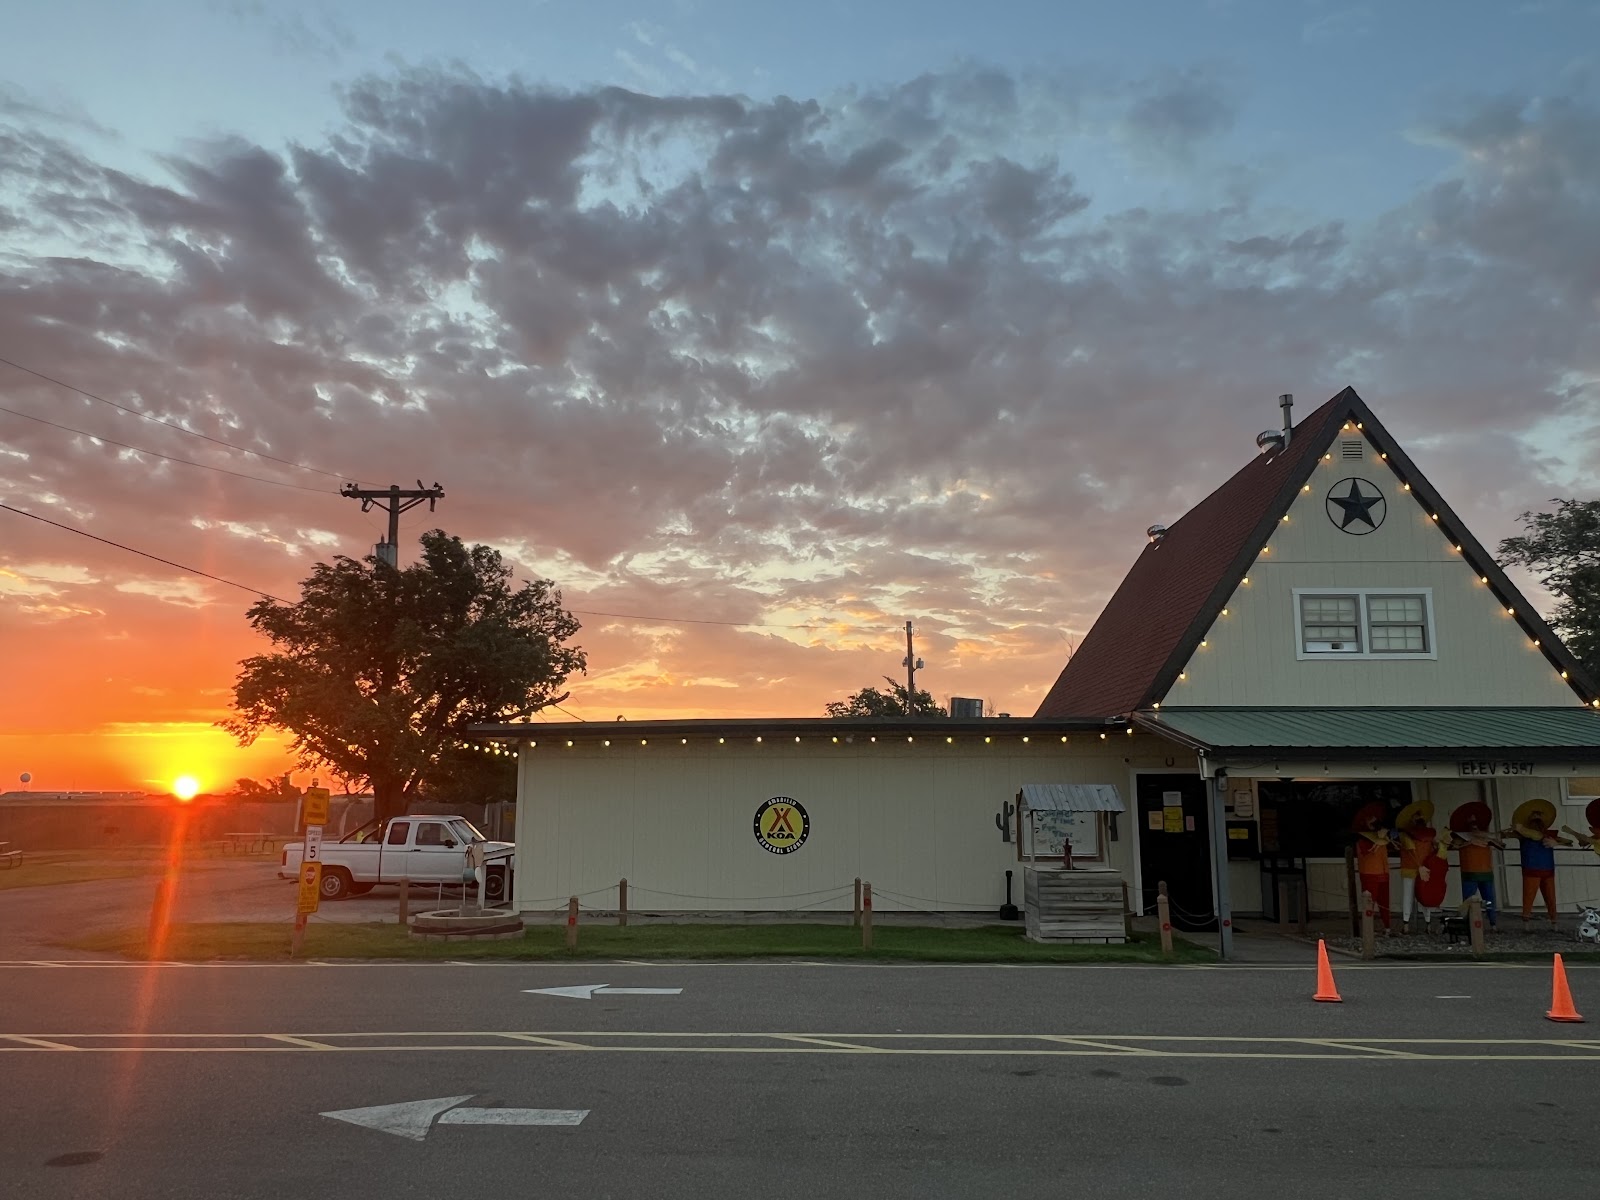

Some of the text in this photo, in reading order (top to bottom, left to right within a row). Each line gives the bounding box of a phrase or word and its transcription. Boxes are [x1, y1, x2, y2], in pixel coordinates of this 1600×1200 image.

[767, 832, 796, 840] KOA
[758, 837, 784, 854] GENERAL
[309, 846, 316, 858] 5
